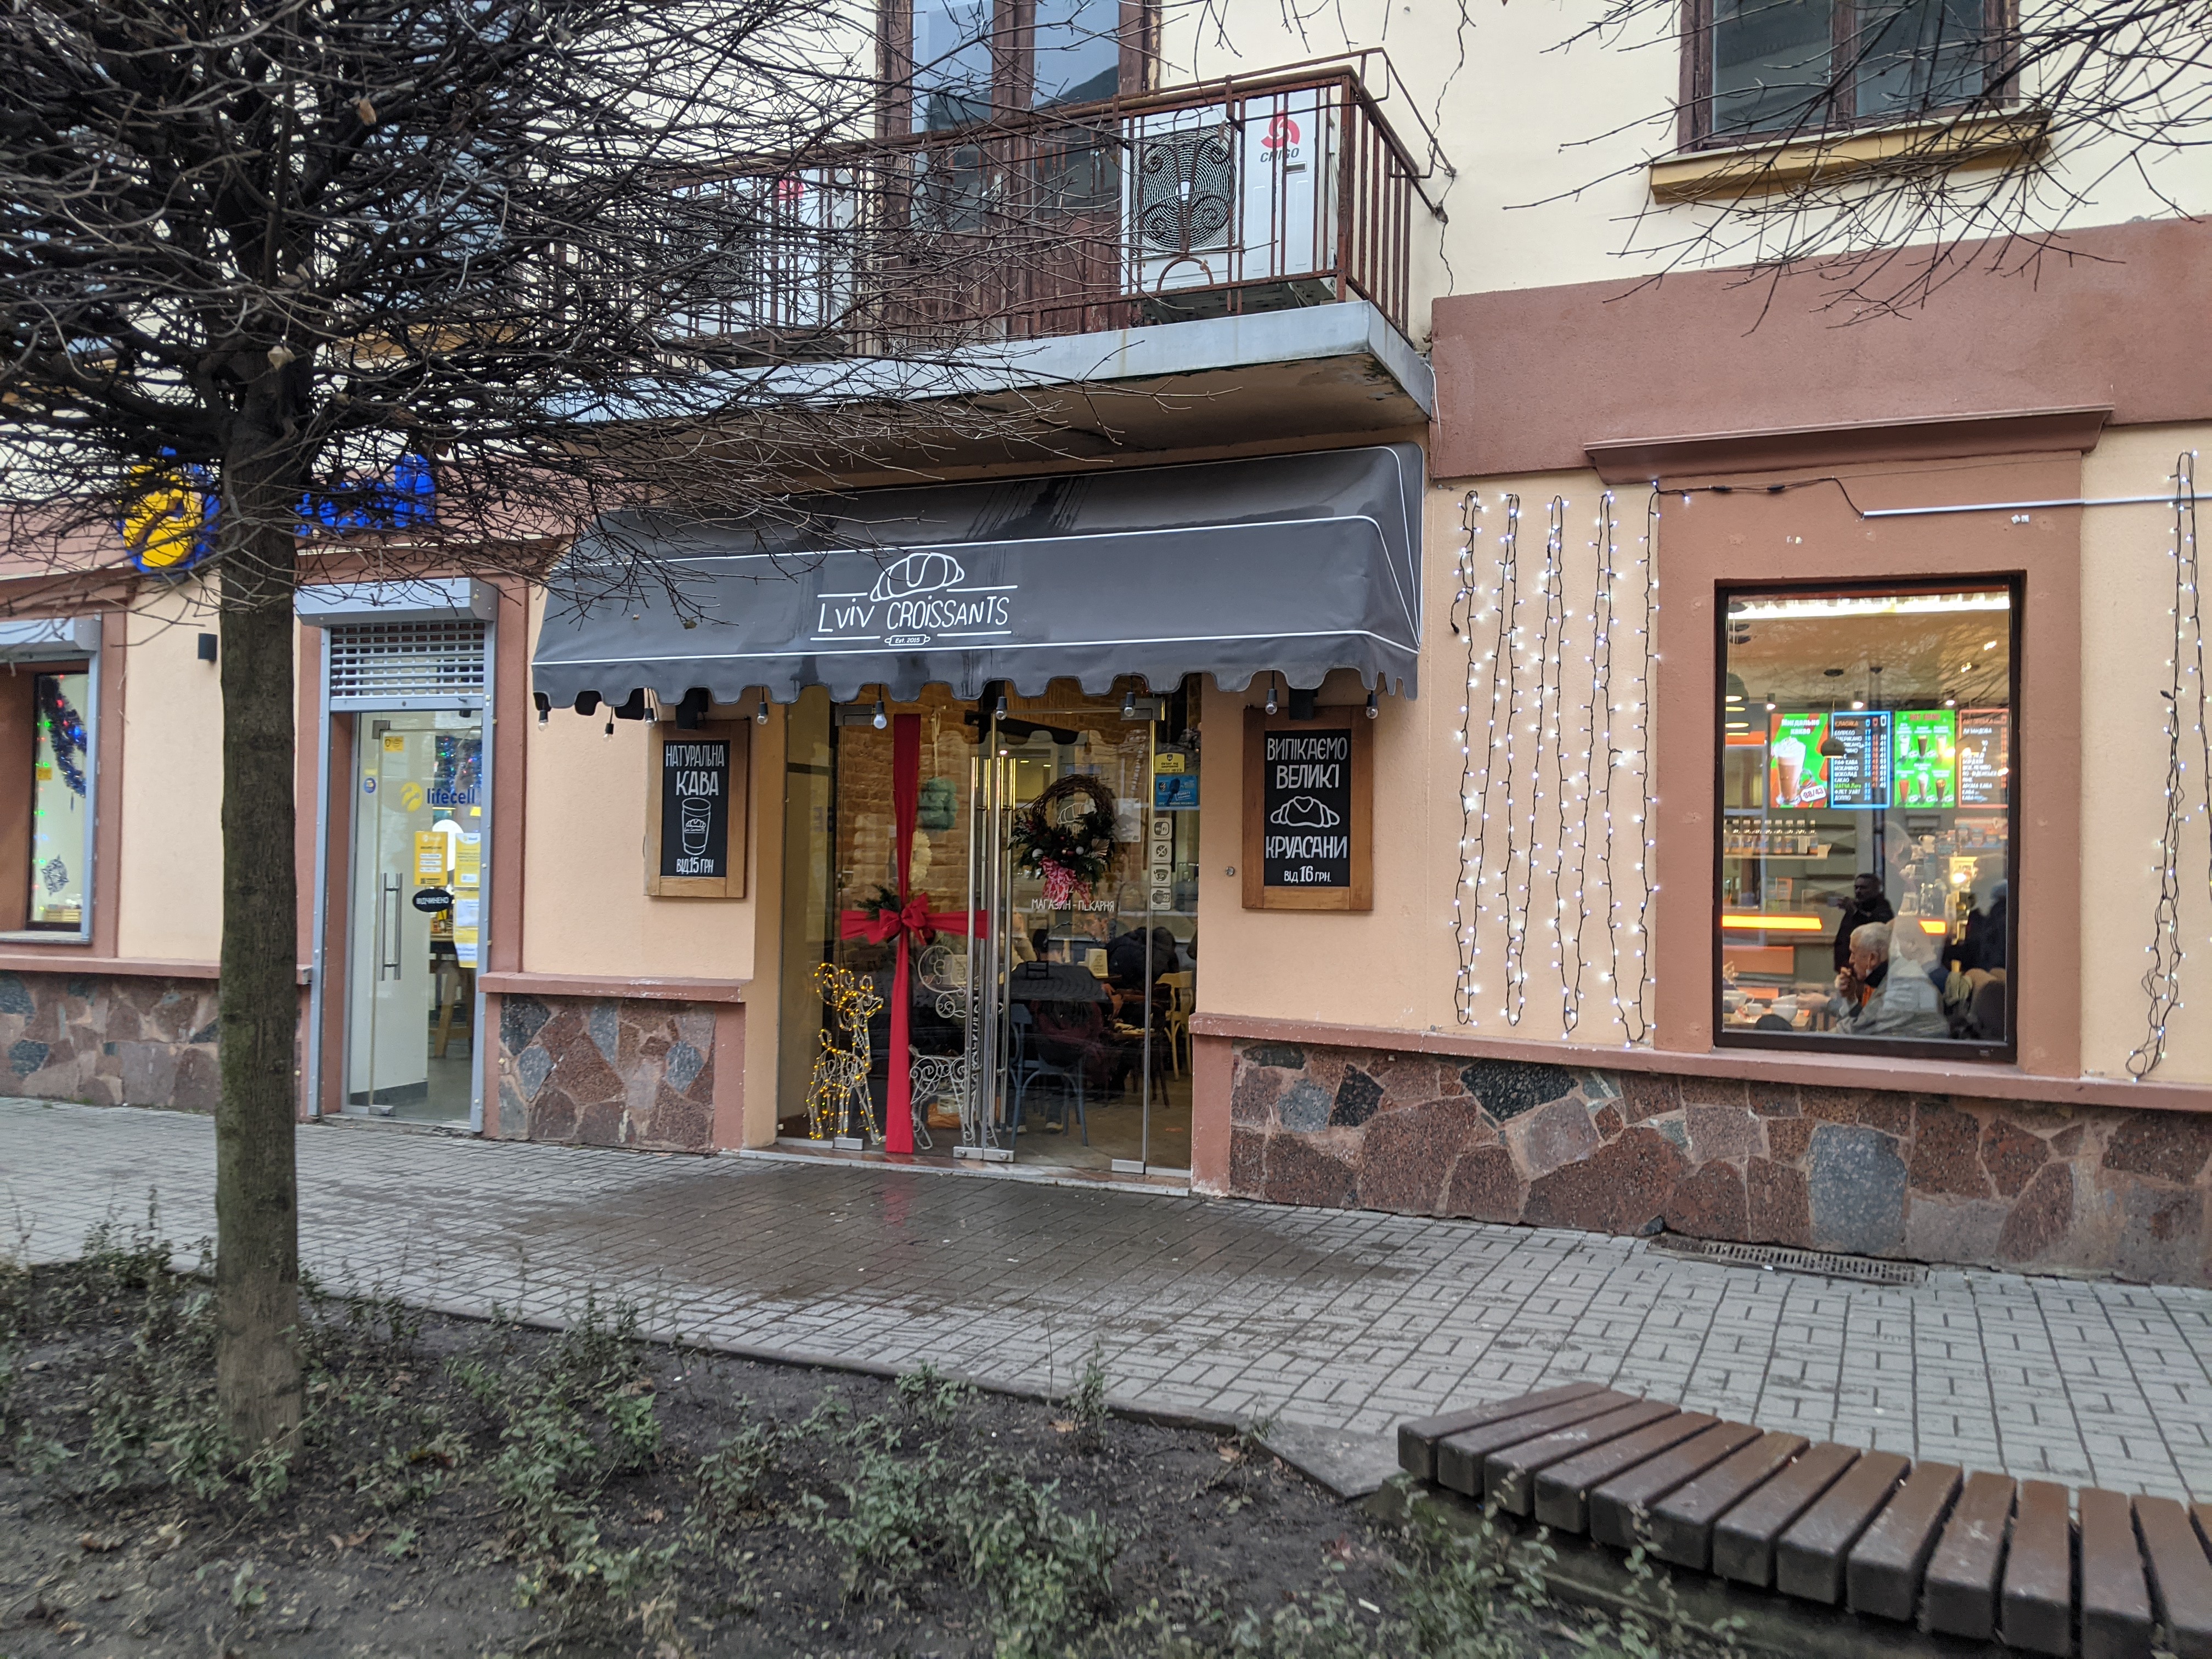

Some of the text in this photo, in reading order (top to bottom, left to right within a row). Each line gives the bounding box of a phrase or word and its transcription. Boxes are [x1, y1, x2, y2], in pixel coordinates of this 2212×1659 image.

[665, 744, 725, 767] НАТУРАЛЬНА
[1267, 737, 1347, 761] ВИПІКАЄМО
[675, 770, 719, 795] КАВА
[1276, 764, 1339, 789] ВЕЛИКІ
[427, 788, 475, 804] lifecell
[1266, 836, 1347, 859] КРУАСАНИ
[1299, 865, 1313, 882] 16
